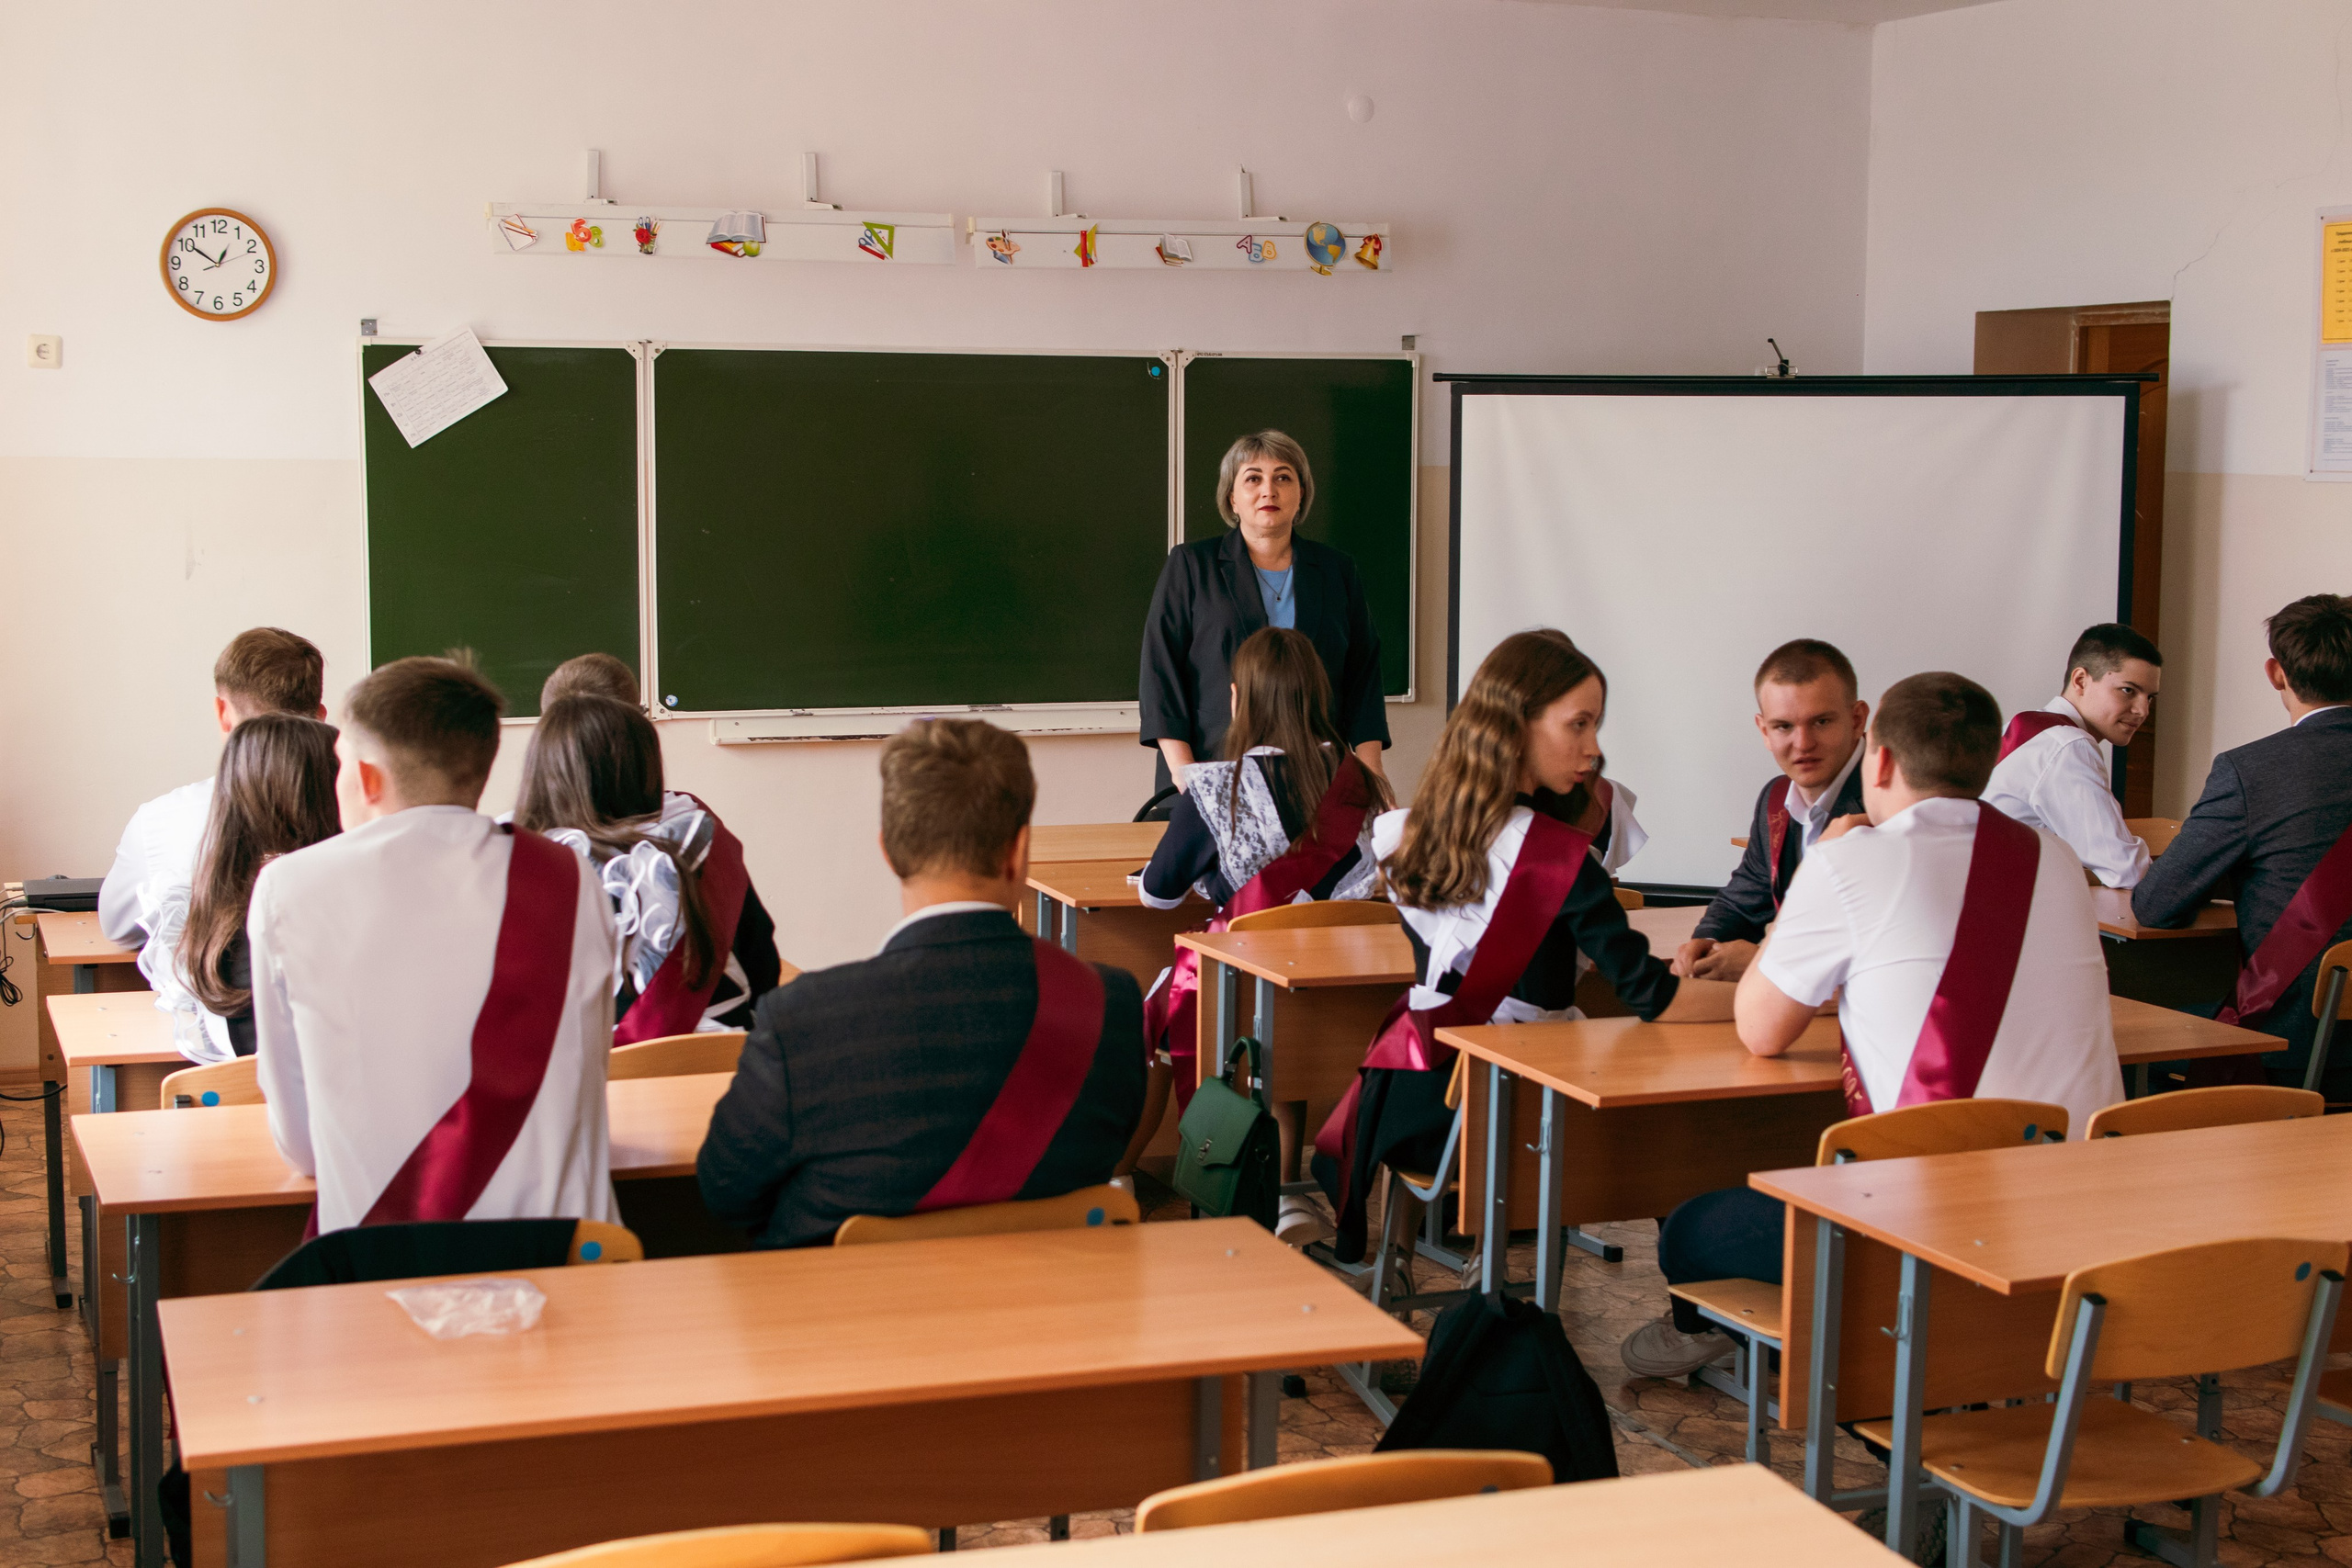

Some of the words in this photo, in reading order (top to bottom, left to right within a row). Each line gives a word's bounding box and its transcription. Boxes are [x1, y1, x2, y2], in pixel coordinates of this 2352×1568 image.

[192, 223, 205, 238] 11
[210, 219, 228, 234] 12
[234, 225, 241, 240] 1
[177, 237, 196, 253] 10
[246, 239, 257, 254] 2
[170, 255, 181, 270] 9
[254, 259, 265, 274] 3
[178, 276, 189, 291] 8
[246, 279, 257, 293] 4
[194, 290, 205, 305] 7
[213, 296, 224, 310] 6
[232, 292, 243, 307] 5
